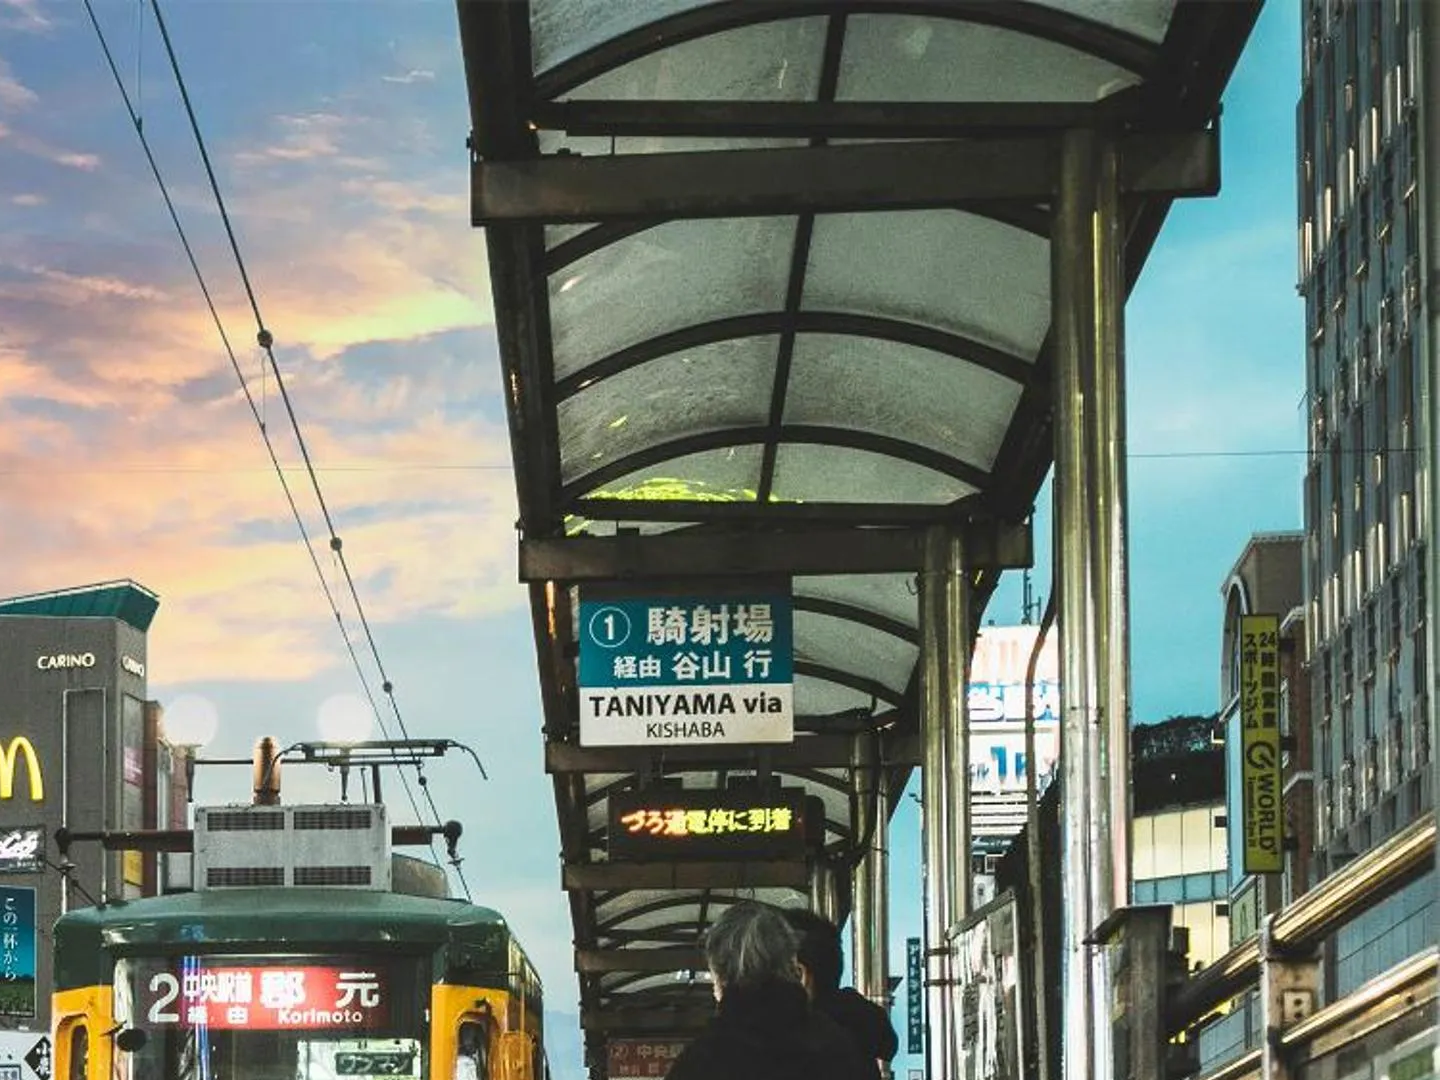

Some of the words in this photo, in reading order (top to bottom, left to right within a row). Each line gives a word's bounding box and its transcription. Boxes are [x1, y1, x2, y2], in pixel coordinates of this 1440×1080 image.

[647, 604, 773, 646] 騎射場
[37, 652, 96, 669] CARINO
[589, 694, 736, 716] TANIYAMA
[743, 692, 782, 714] via
[646, 722, 725, 738] KISHABA
[3, 897, 18, 982] この一杯から
[148, 973, 179, 1023] 2
[278, 1006, 363, 1024] Korimoto
